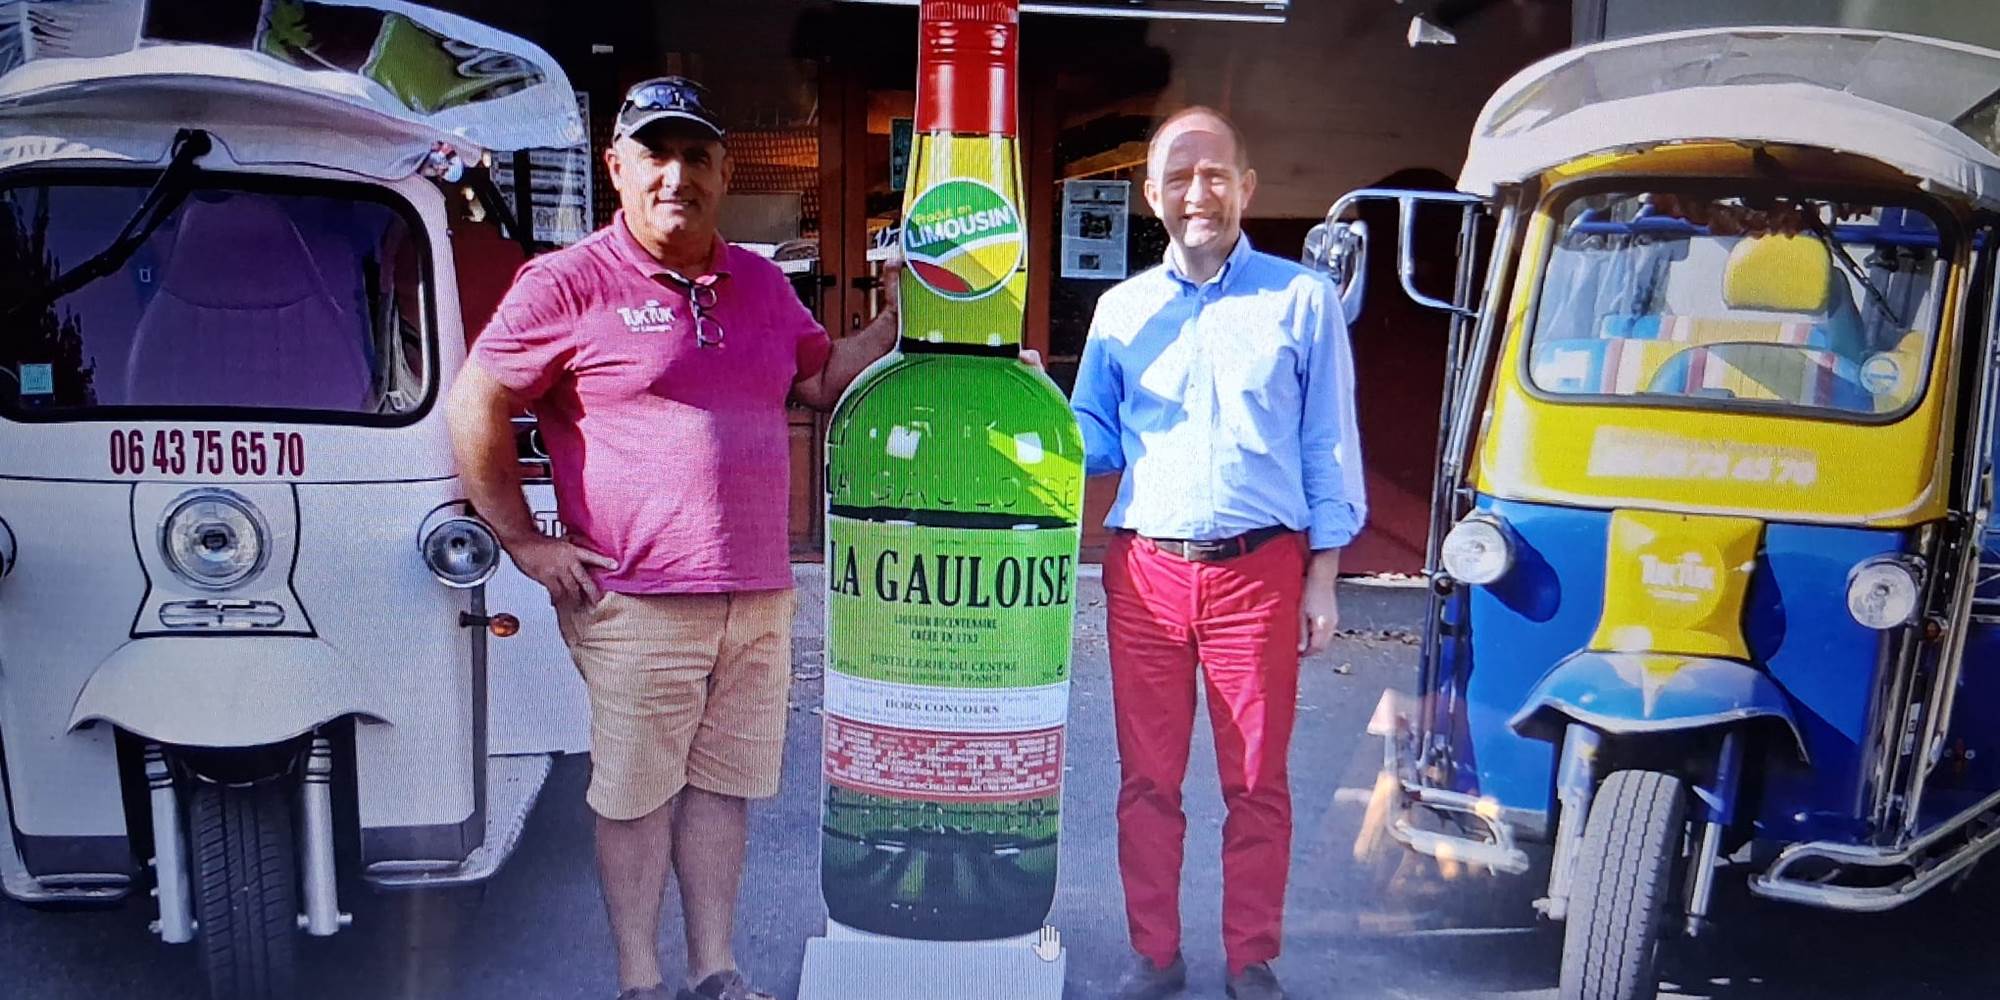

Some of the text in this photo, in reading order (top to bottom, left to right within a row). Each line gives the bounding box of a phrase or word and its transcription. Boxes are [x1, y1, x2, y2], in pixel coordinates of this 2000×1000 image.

[907, 205, 1011, 247] LIMOUSIN
[110, 428, 305, 477] 06 43 75 65 70
[829, 541, 1071, 608] LA GAULOISE
[870, 653, 945, 671] DISTILLERIE
[950, 661, 968, 670] DU
[971, 661, 1017, 673] CENTRE
[960, 673, 1002, 683] FRANCE
[885, 698, 921, 711] HORS
[925, 700, 1000, 714] CONCOURS
